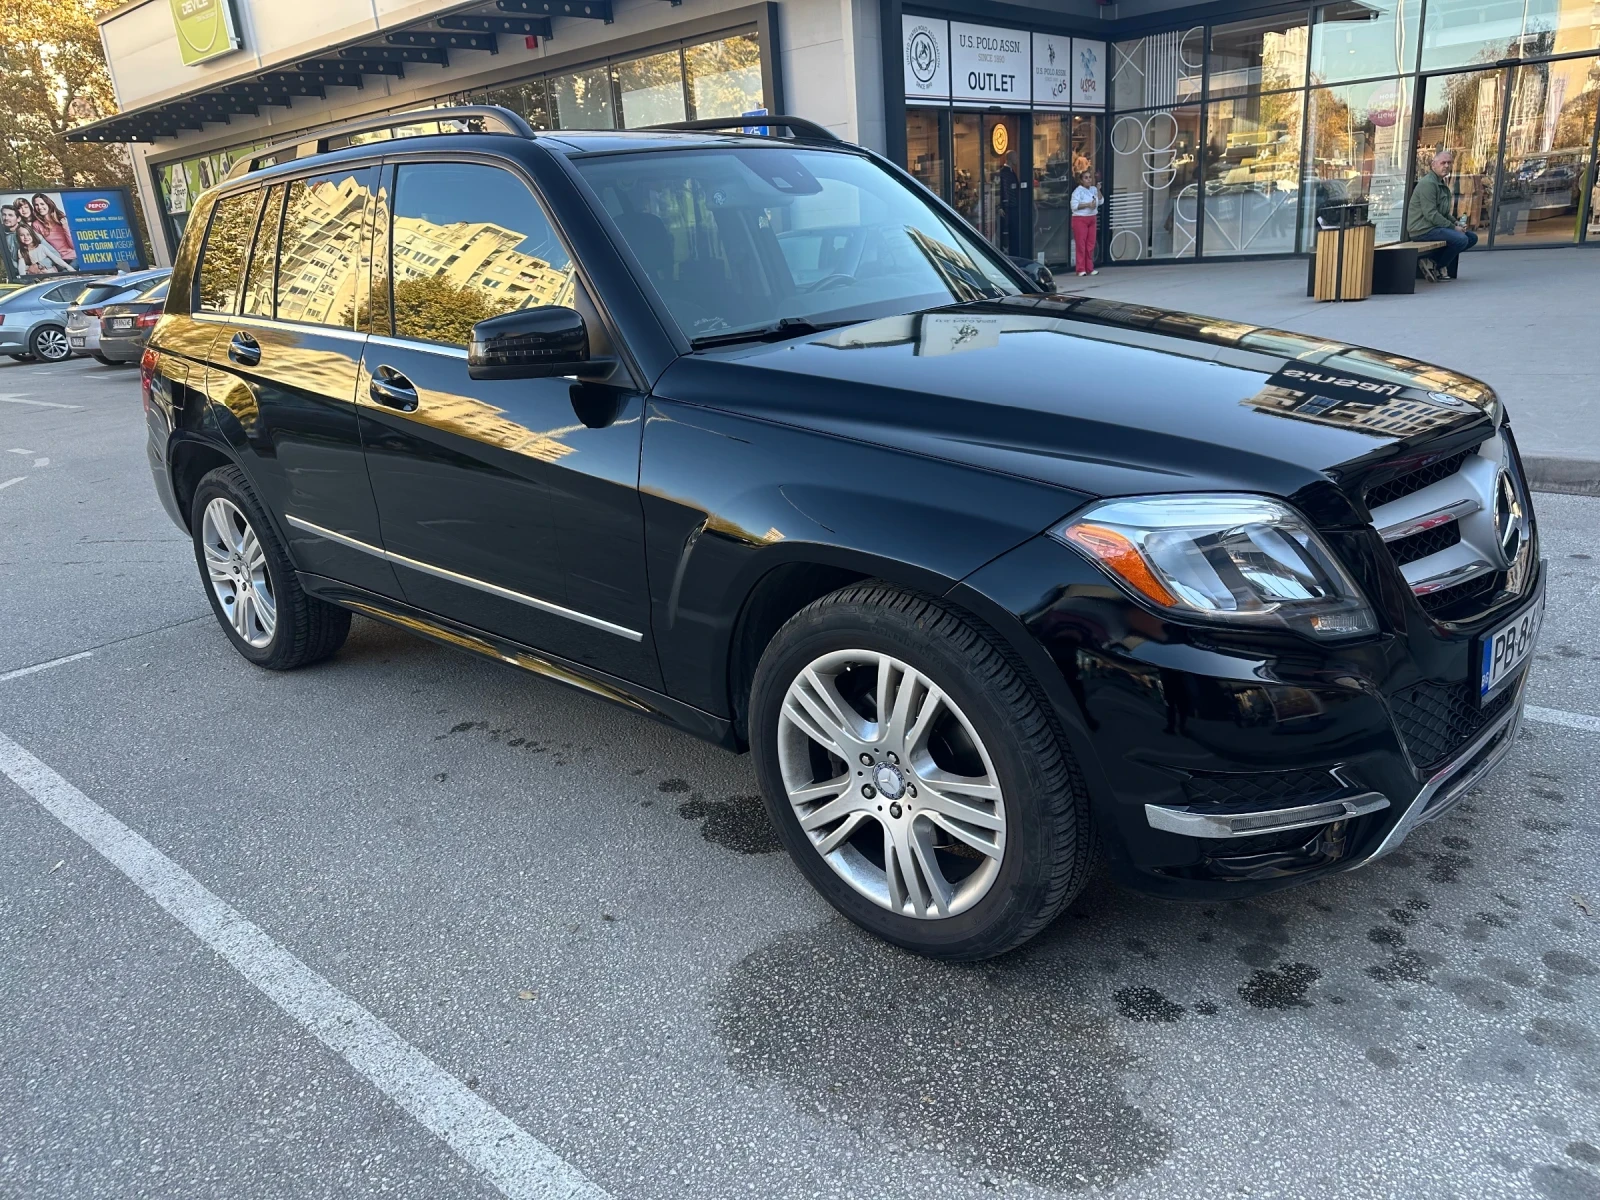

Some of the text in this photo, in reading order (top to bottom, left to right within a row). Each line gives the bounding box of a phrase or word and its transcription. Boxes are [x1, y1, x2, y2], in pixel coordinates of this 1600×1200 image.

[959, 34, 1022, 53] U.S. POLO ASSN.
[977, 53, 993, 63] SINCE
[1044, 68, 1055, 76] POLO
[968, 71, 1016, 92] OUTLET
[76, 229, 110, 241] ПОВЕЧЕ
[80, 240, 134, 251] ПО-ГОЛЯМ ИЗБОР
[82, 250, 137, 264] НИСКИ ЦЕНИ
